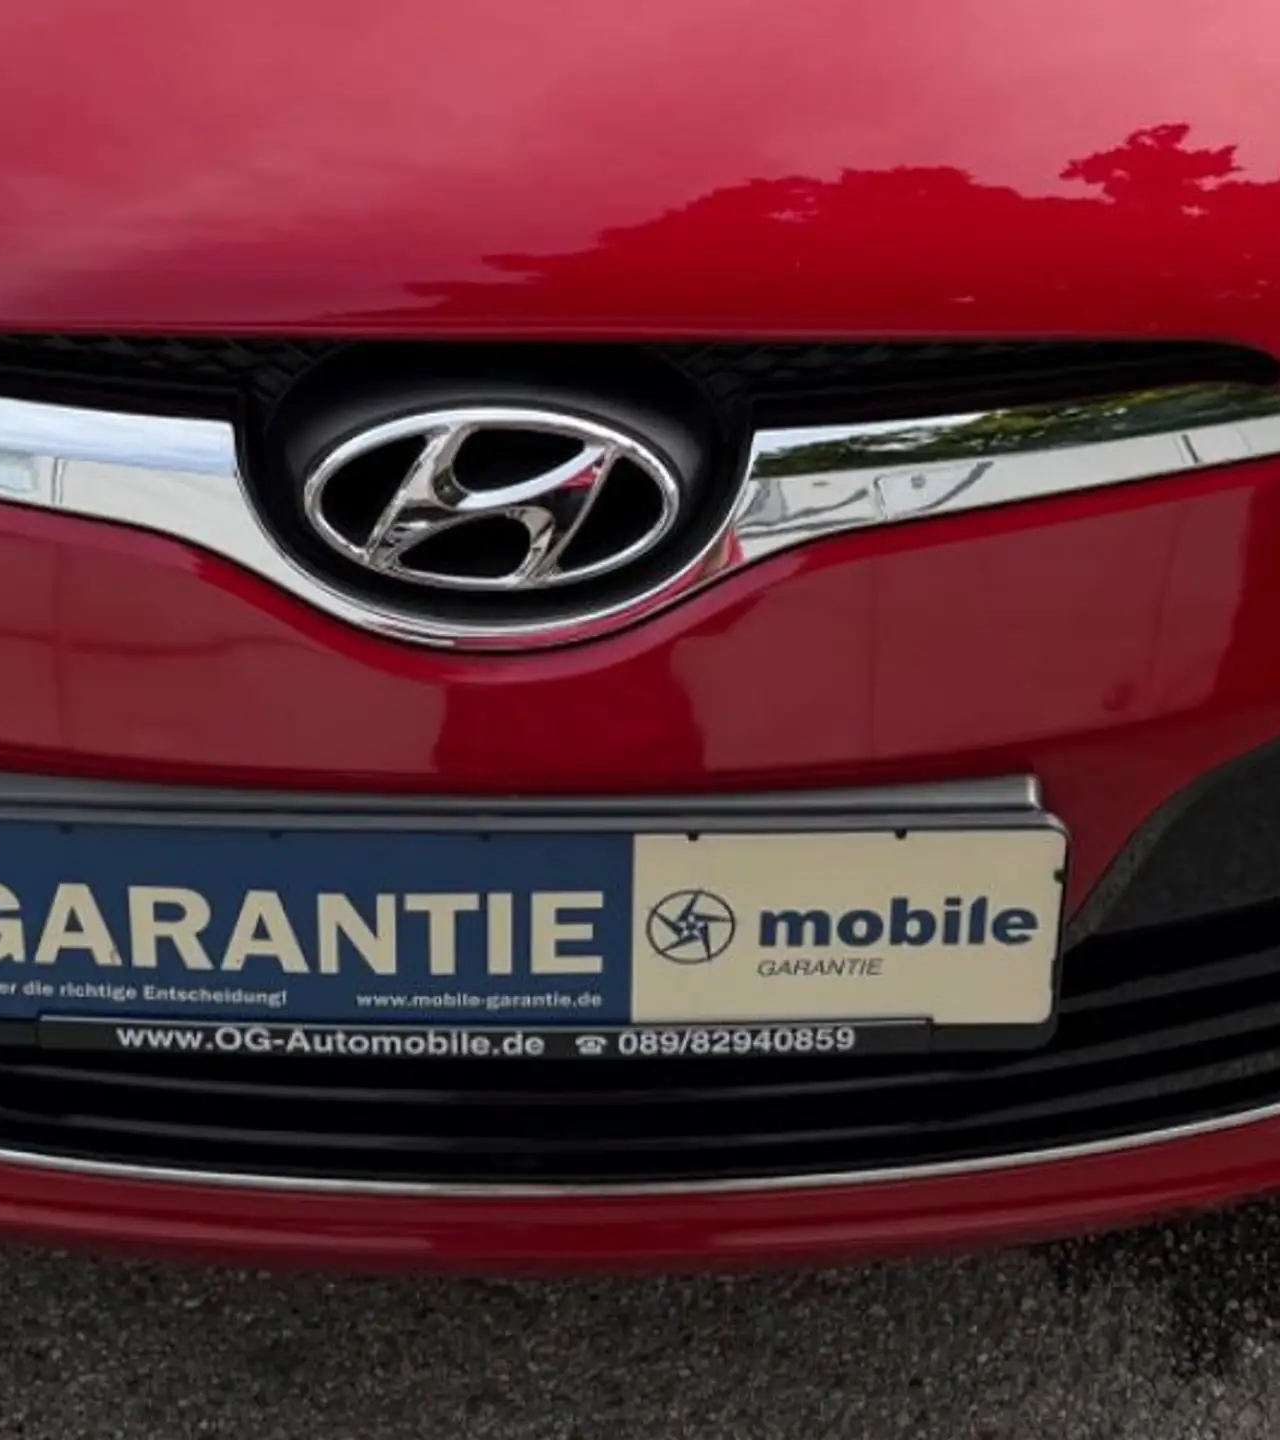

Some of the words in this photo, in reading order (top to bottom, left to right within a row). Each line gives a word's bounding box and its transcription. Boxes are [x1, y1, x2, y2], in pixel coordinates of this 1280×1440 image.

[758, 896, 1039, 948] mobile
[756, 957, 886, 977] GARANTIE
[22, 980, 54, 998] die
[59, 981, 138, 1003] richtige
[143, 984, 287, 1007] Entscheidung!
[355, 990, 603, 1010] www.mobile-garantie.de
[116, 1025, 545, 1056] www.OG-Automobile.de
[618, 1025, 856, 1056] 089/82940859
